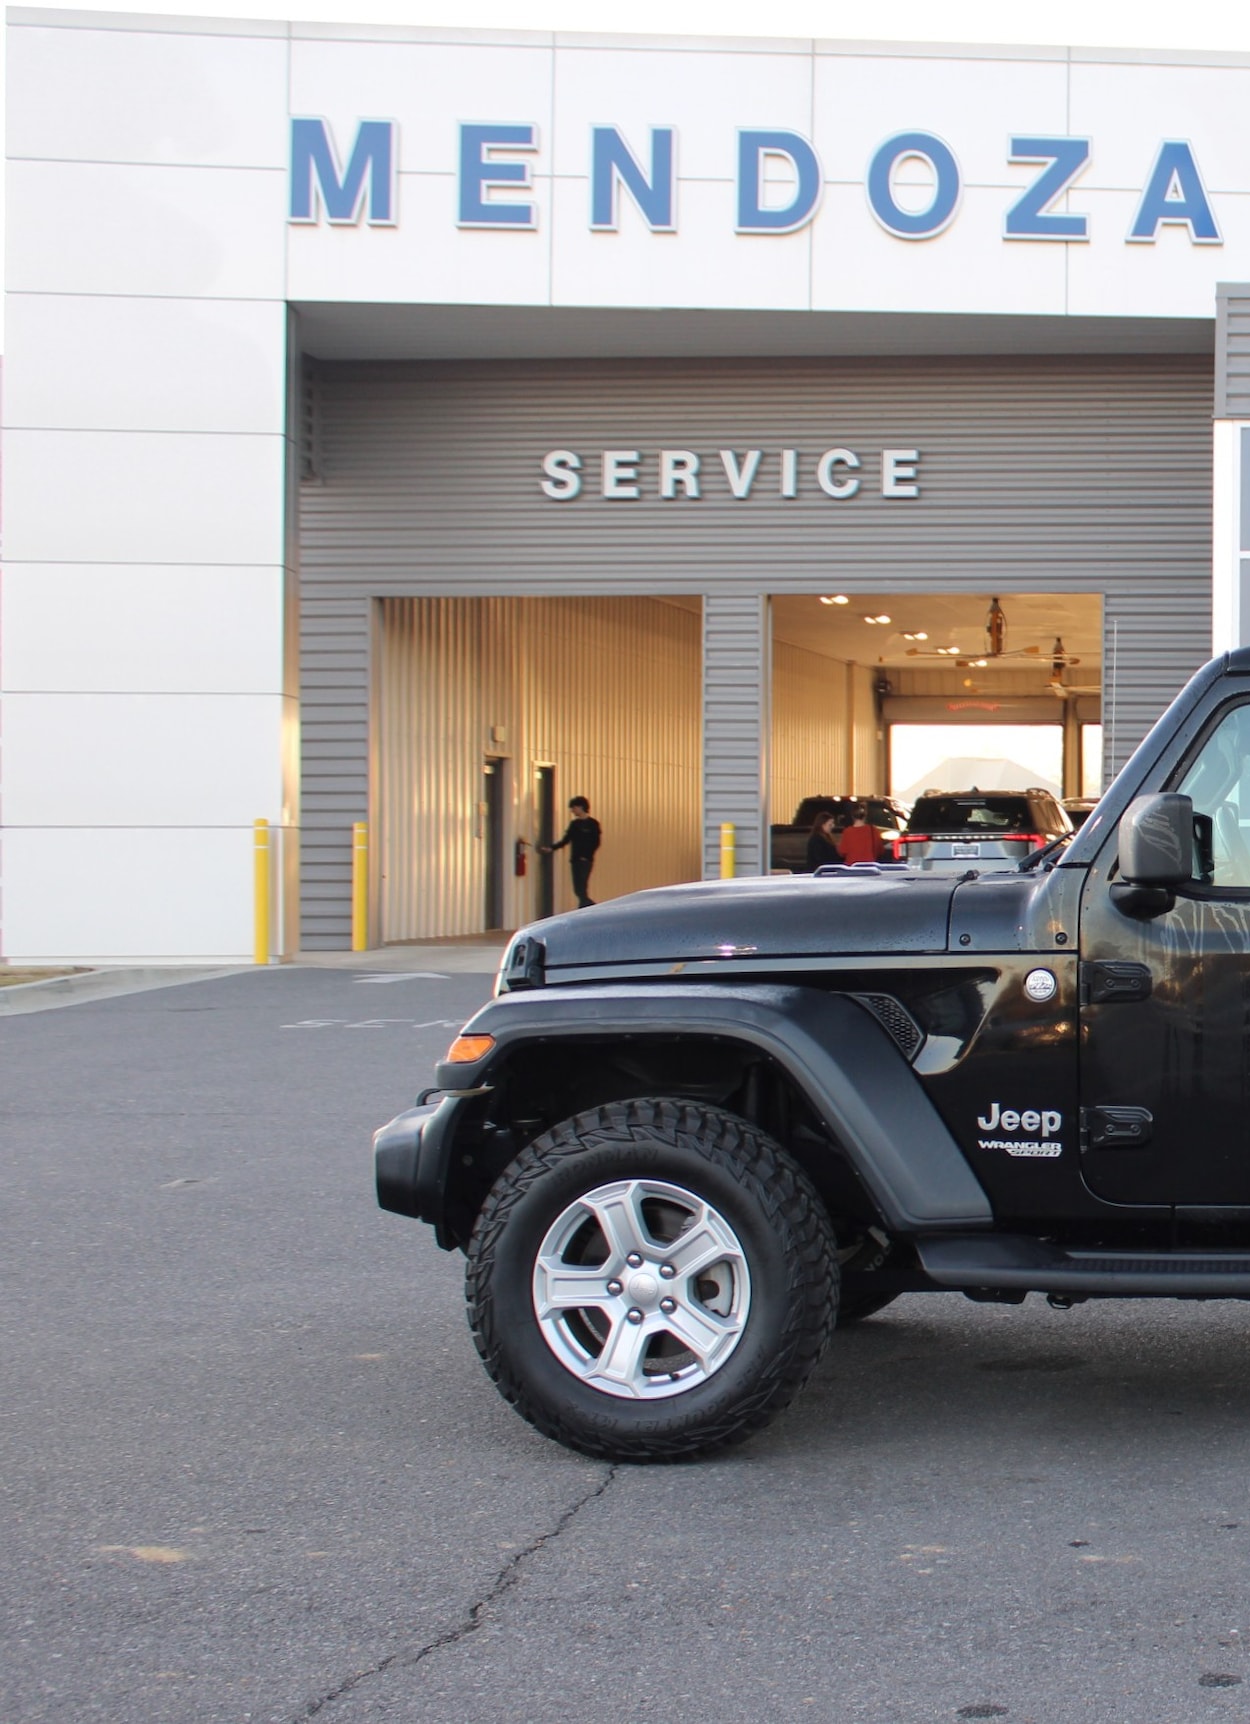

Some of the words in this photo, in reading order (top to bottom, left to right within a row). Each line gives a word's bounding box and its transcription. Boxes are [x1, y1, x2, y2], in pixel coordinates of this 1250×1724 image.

[287, 114, 1225, 247] MENDOZA
[540, 447, 920, 501] SERVICE
[977, 1102, 1062, 1138] Jeep
[977, 1139, 1062, 1150] WRANGLER
